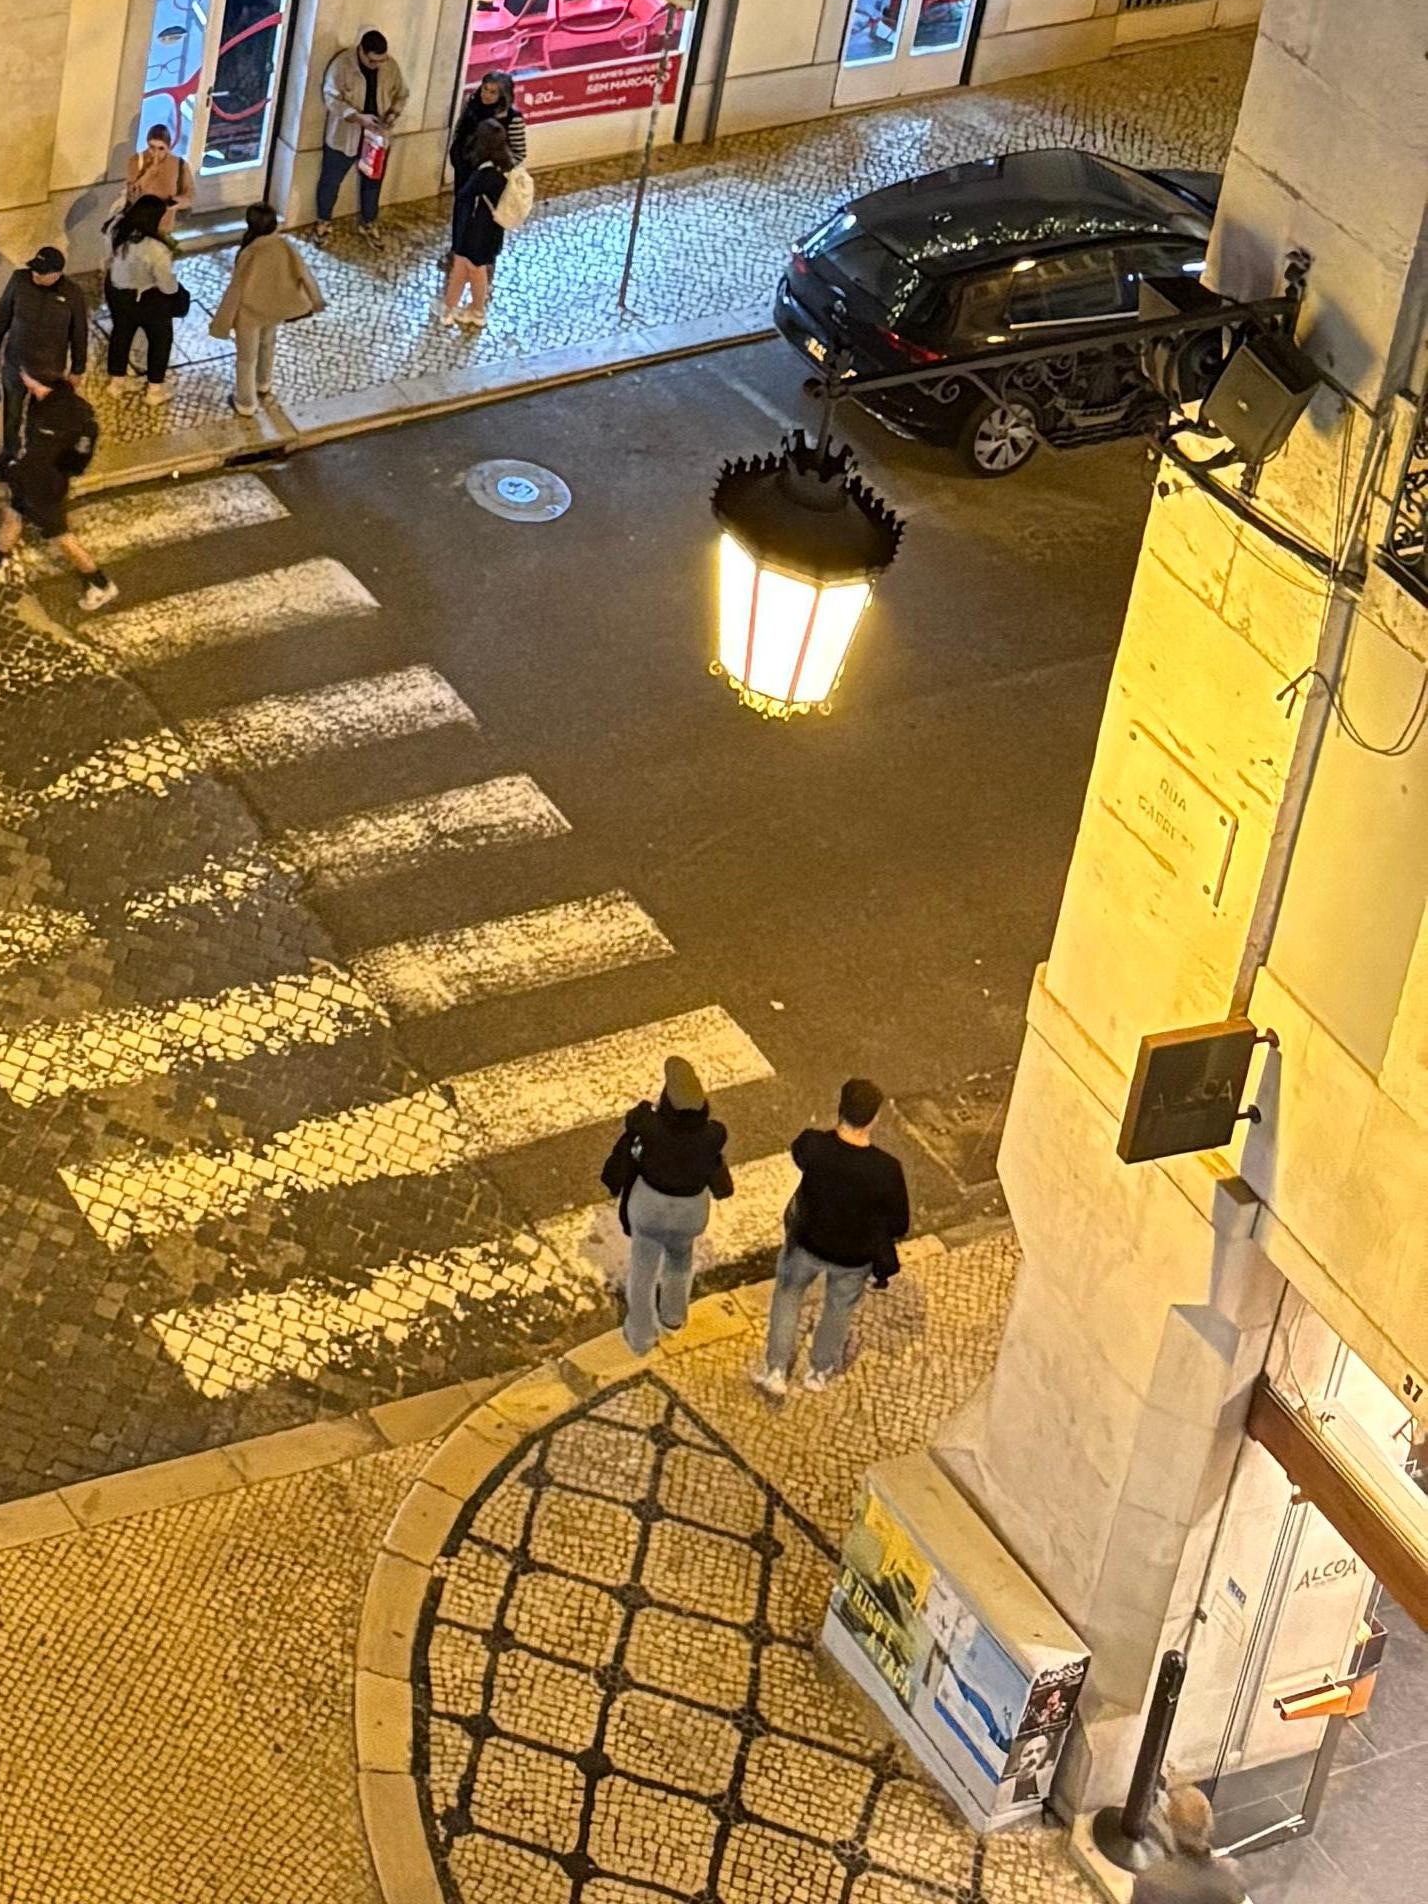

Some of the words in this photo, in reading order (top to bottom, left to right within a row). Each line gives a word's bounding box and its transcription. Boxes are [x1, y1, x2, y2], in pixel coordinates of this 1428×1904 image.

[585, 81, 610, 95] SEM
[610, 71, 671, 91] MARCAÇO
[1294, 1556, 1358, 1593] ALCOA
